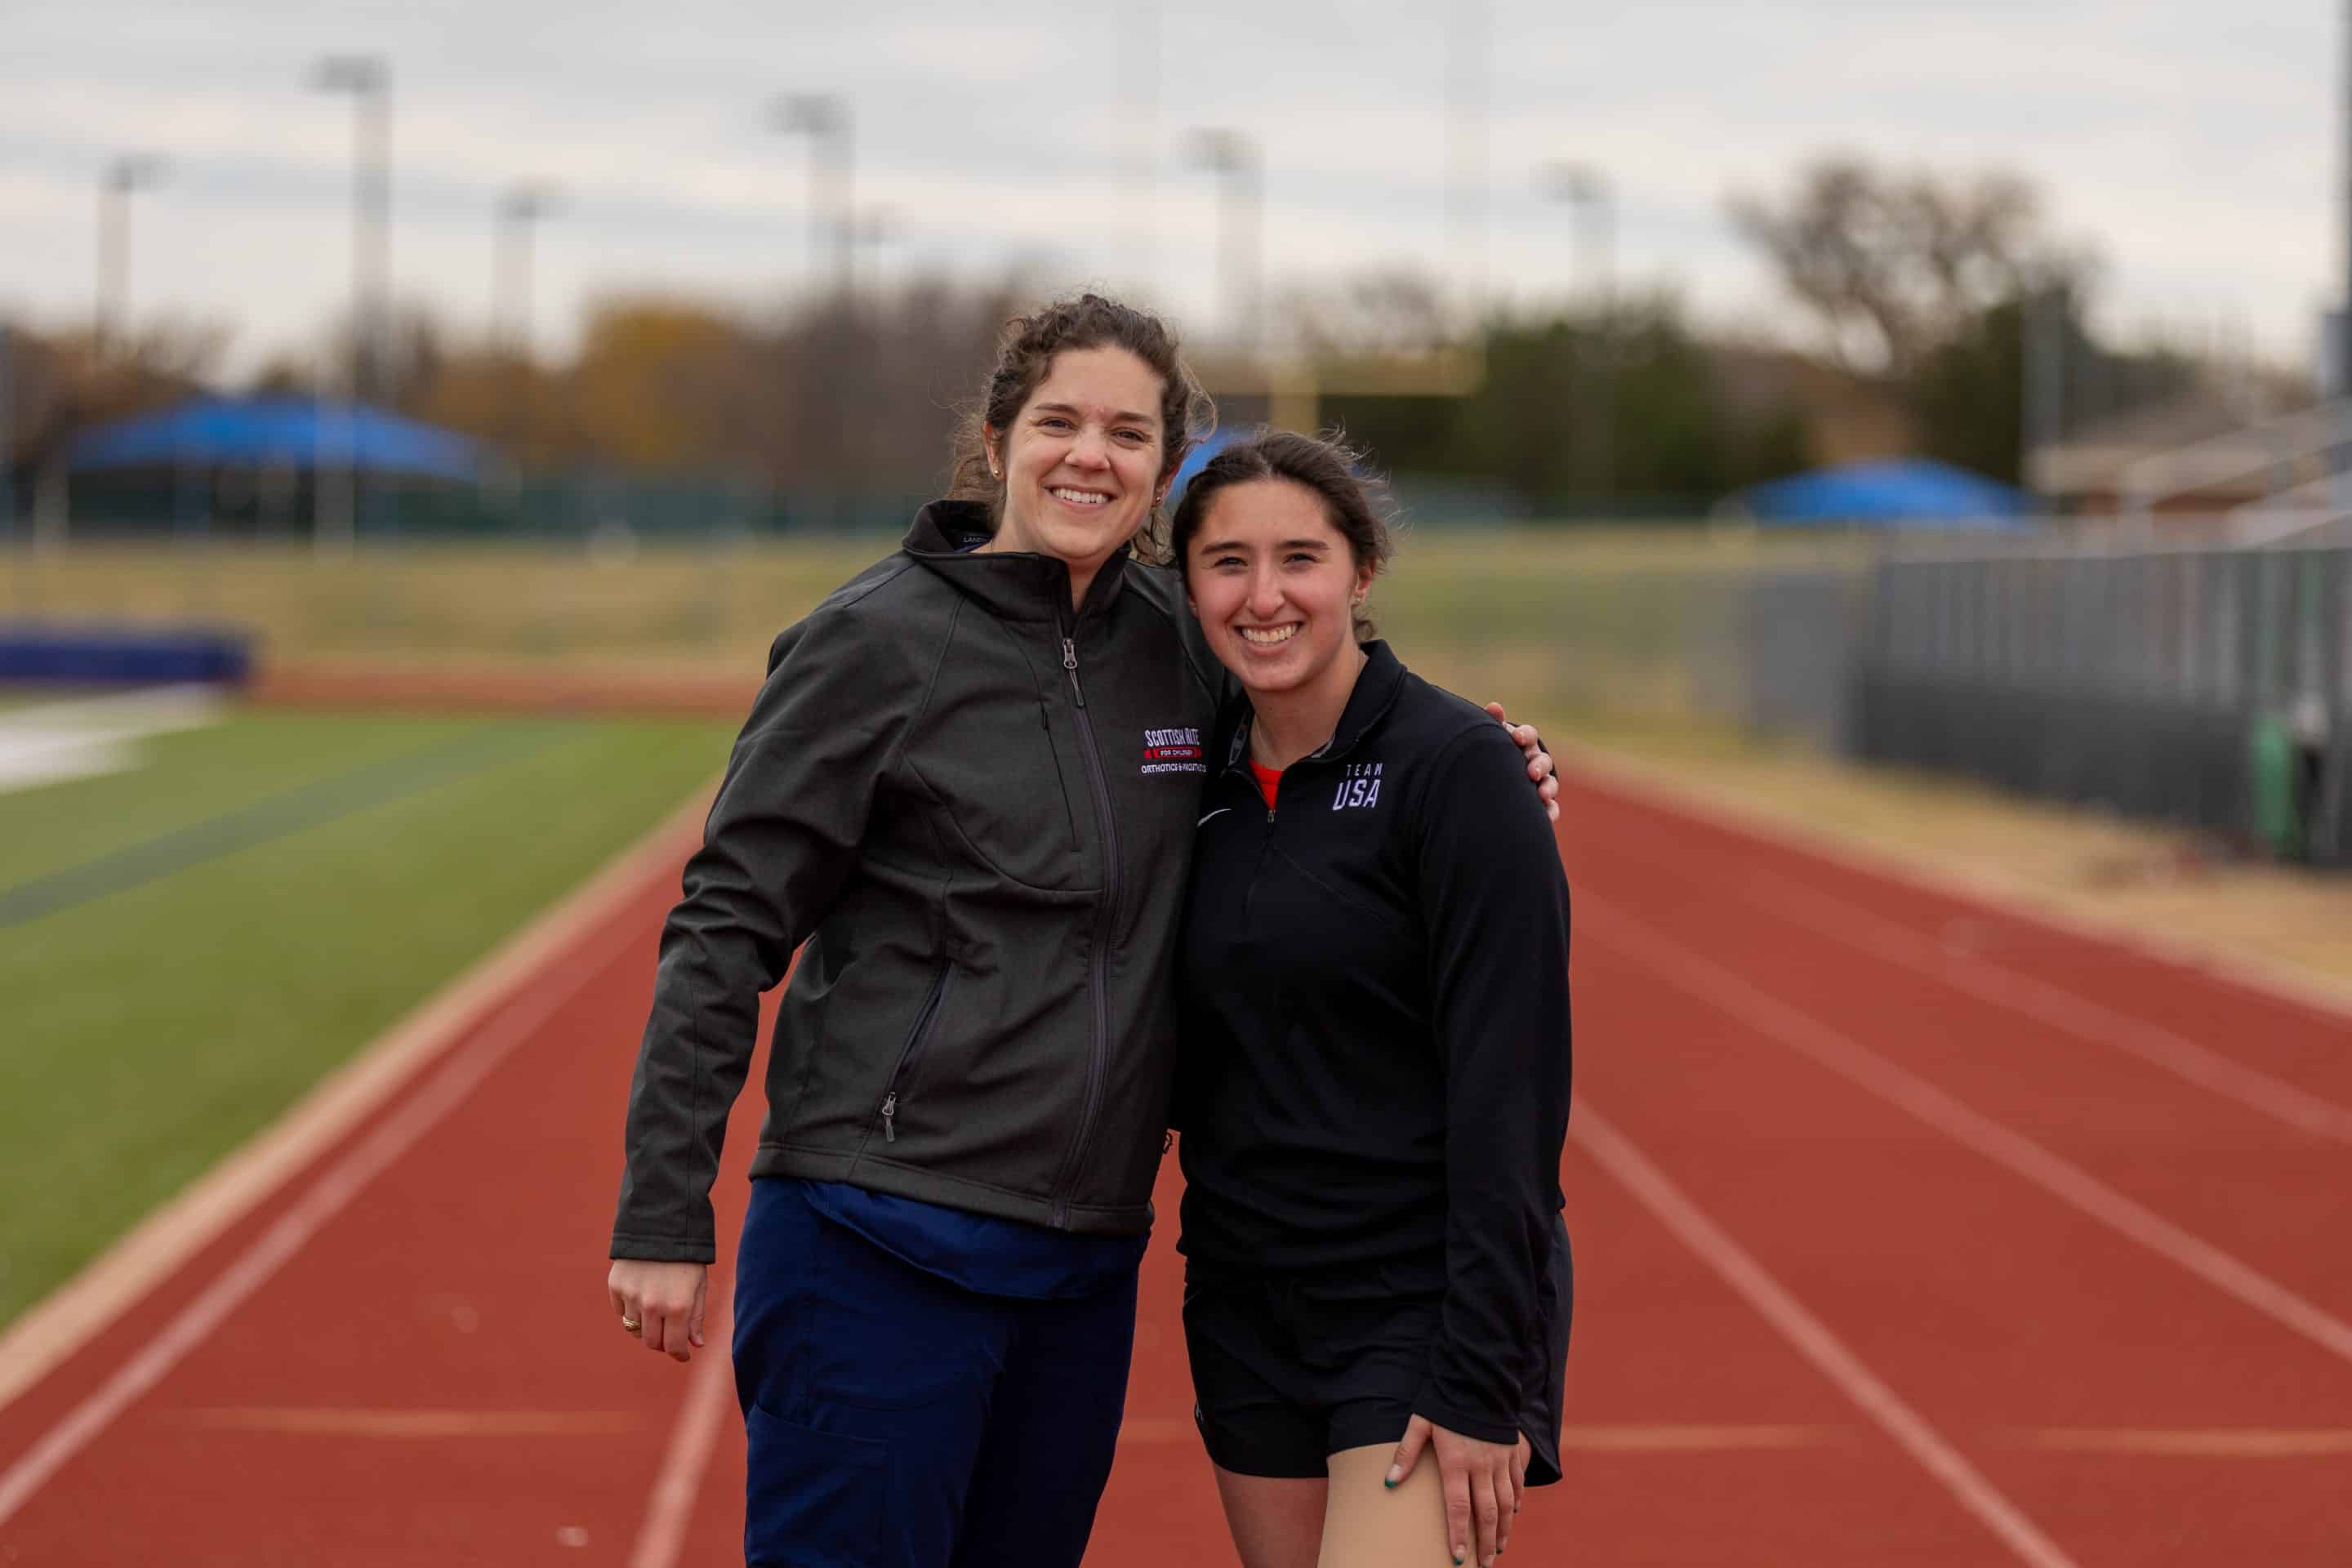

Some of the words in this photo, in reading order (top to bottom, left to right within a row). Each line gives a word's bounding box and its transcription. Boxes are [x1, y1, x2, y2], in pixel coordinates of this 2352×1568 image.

[1145, 729, 1185, 746] SCOTTISH
[1141, 764, 1178, 773] ORTHOTICS
[1346, 763, 1383, 777] TEAM
[1332, 779, 1381, 810] USA
